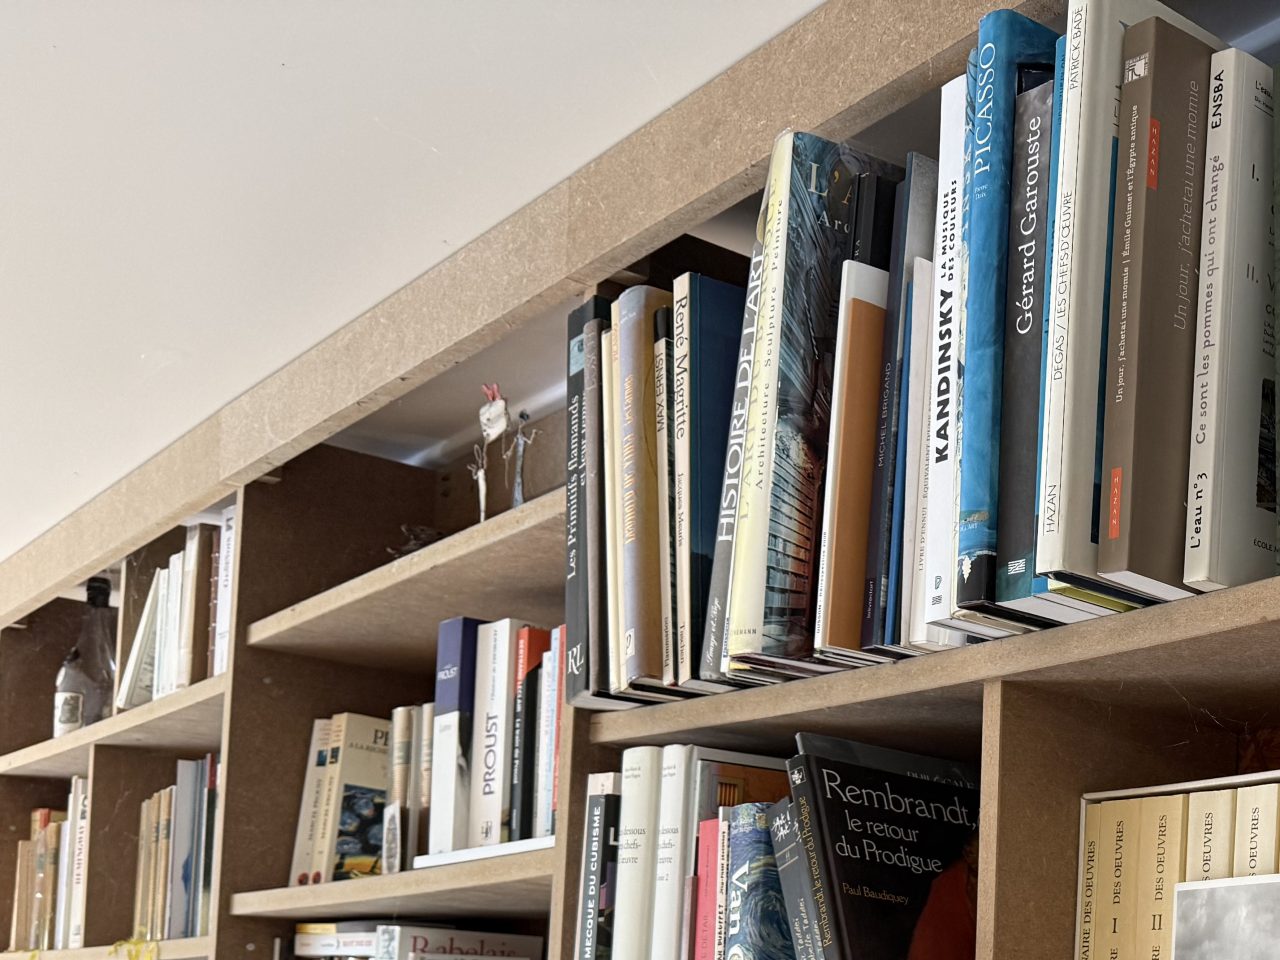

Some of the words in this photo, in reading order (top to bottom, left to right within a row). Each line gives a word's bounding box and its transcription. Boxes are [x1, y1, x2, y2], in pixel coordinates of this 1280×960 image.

[1073, 5, 1084, 39] BADE
[1070, 42, 1081, 91] PATRICK
[975, 42, 996, 177] PICASSO
[1211, 70, 1225, 130] ENSBA
[1021, 116, 1042, 236] Garouste
[744, 250, 764, 333] L'ART
[1016, 238, 1036, 335] Gérard
[675, 296, 688, 349] René
[756, 382, 770, 490] Architecture
[764, 286, 777, 367] Sculpture
[772, 199, 783, 270] Peinture
[655, 353, 664, 398] ERNST
[736, 340, 753, 392] DE
[935, 289, 954, 464] KANDINSKY
[656, 400, 665, 433] MAX
[675, 353, 688, 440] Magritte
[568, 395, 579, 472] flamands
[717, 397, 748, 542] HISTOIRE
[567, 474, 579, 547] Primitifs
[1046, 484, 1057, 533] HAZAN
[567, 549, 577, 580] Les
[482, 712, 499, 796] PROUST
[822, 768, 978, 830] Rembrandt,
[844, 809, 862, 833] le
[866, 821, 920, 843] retour
[590, 806, 601, 876] CUBISME
[835, 835, 860, 860] du
[862, 839, 944, 875] Prodigue
[1156, 814, 1167, 875] OEUVRES
[588, 878, 597, 899] DU
[729, 860, 750, 937] Van
[842, 882, 862, 897] Paul
[862, 885, 910, 906] Baudiquey
[1154, 877, 1164, 902] DES
[585, 900, 595, 960] MECQUE
[1151, 914, 1163, 931] II
